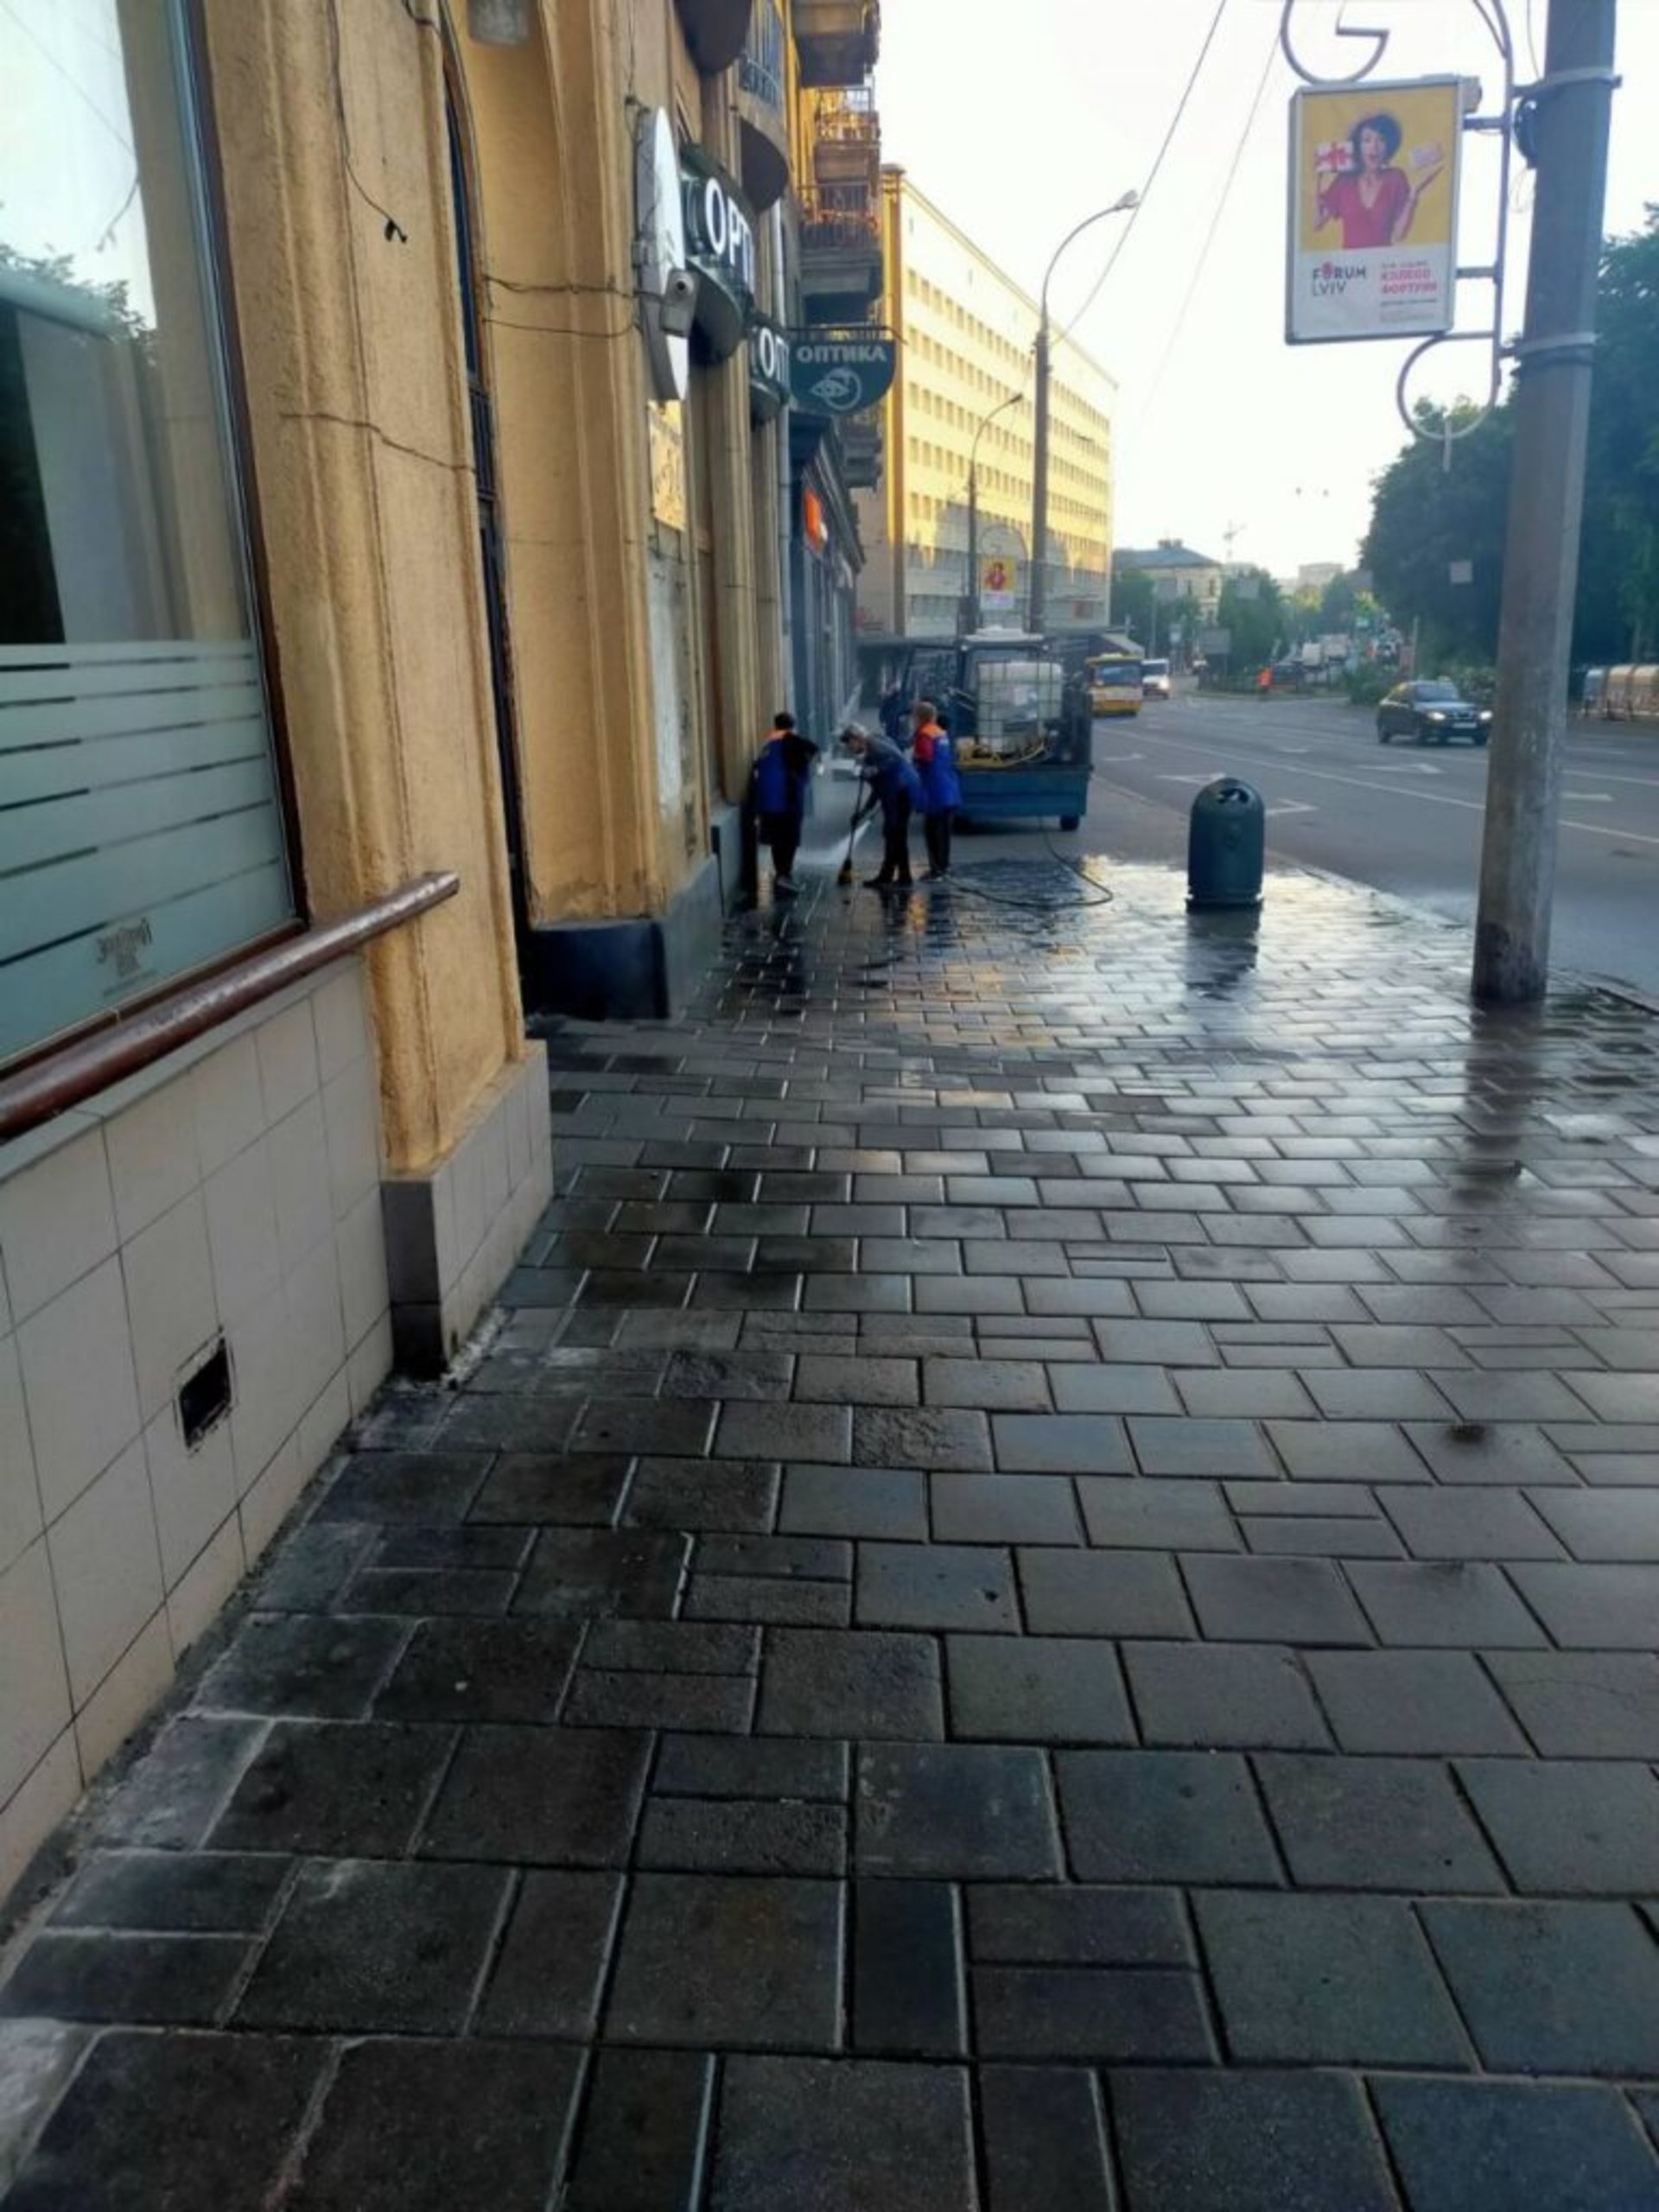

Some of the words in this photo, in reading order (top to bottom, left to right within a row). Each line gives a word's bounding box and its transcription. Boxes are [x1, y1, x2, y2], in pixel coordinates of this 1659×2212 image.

[1313, 261, 1366, 279] FORUM
[1313, 280, 1347, 296] LVIV
[797, 346, 887, 364] ОПТИКА
